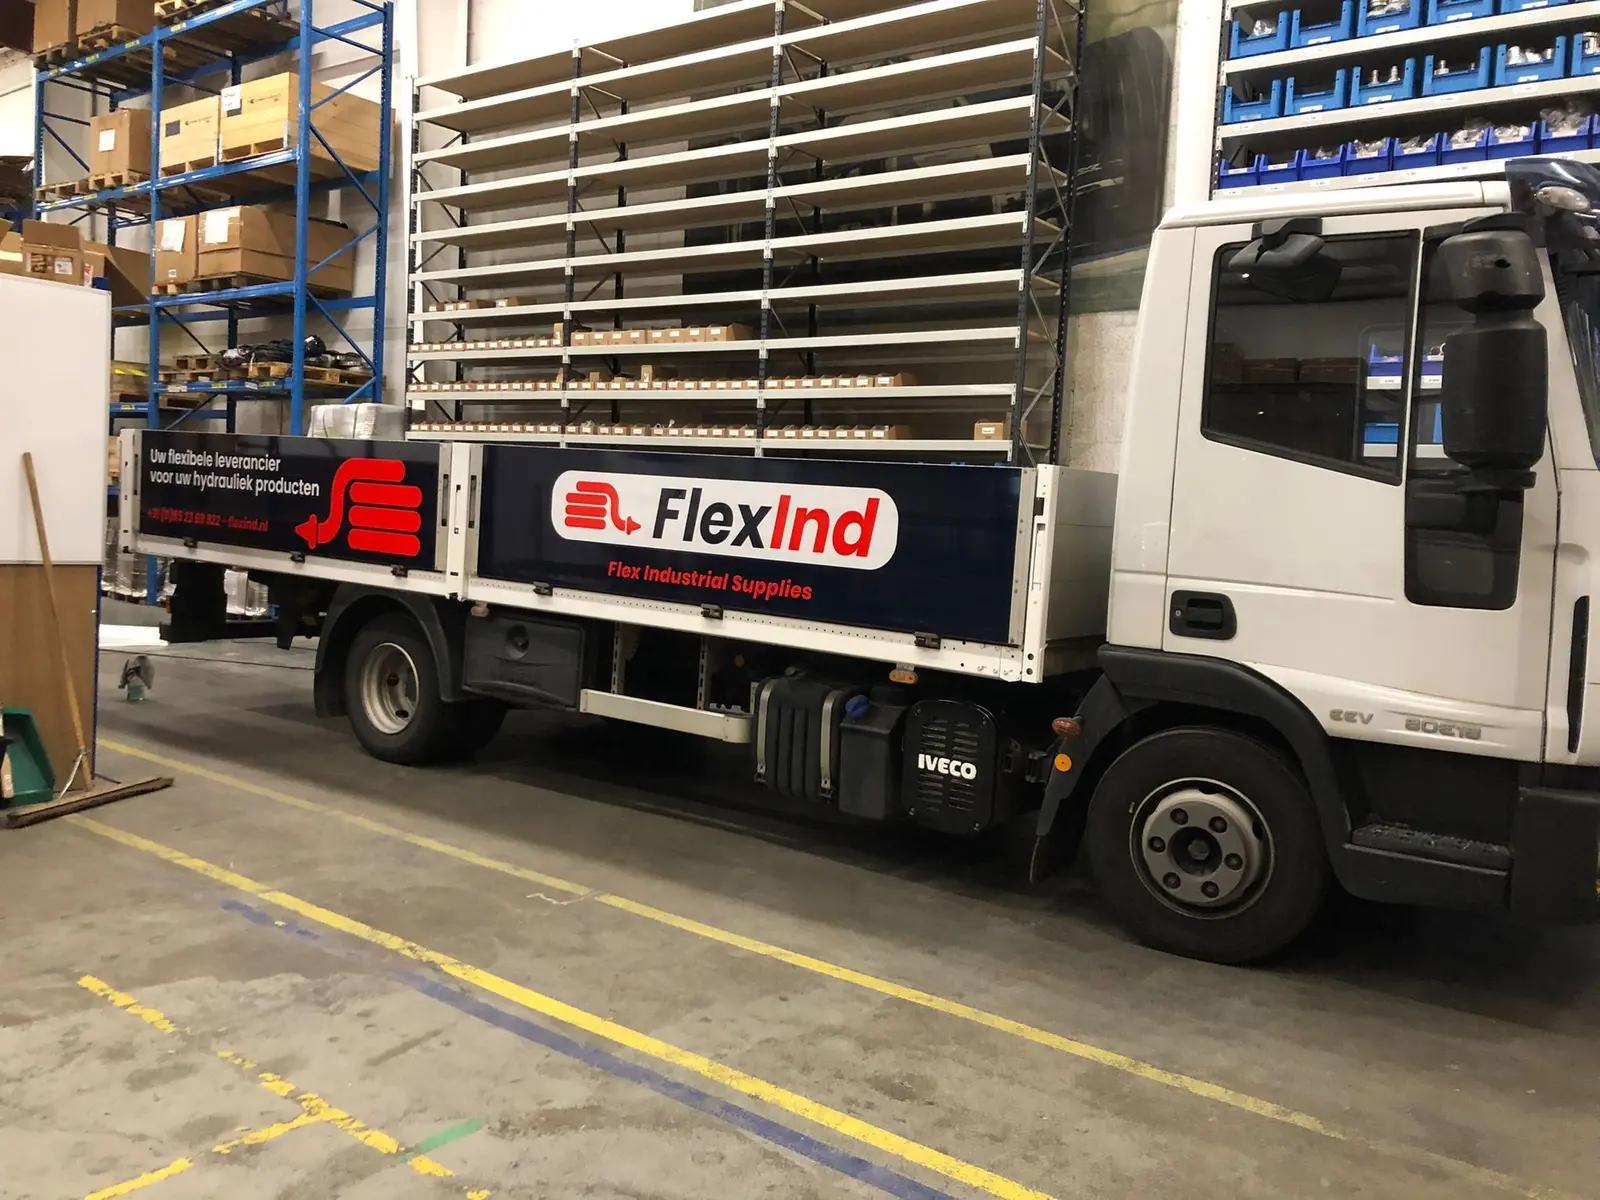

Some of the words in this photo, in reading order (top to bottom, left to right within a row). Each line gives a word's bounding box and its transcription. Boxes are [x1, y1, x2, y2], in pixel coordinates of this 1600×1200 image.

[150, 448, 167, 464] Uw
[168, 448, 213, 467] flexibele
[215, 451, 281, 472] leverancier
[150, 470, 173, 484] voor
[175, 474, 192, 486] uw
[193, 470, 253, 492] hydrauliek
[255, 477, 320, 497] producten
[652, 487, 881, 558] FlexInd
[607, 560, 641, 580] Flex
[643, 564, 730, 590] Industrial
[731, 574, 813, 601] Supplies
[917, 753, 977, 780] IVECO
